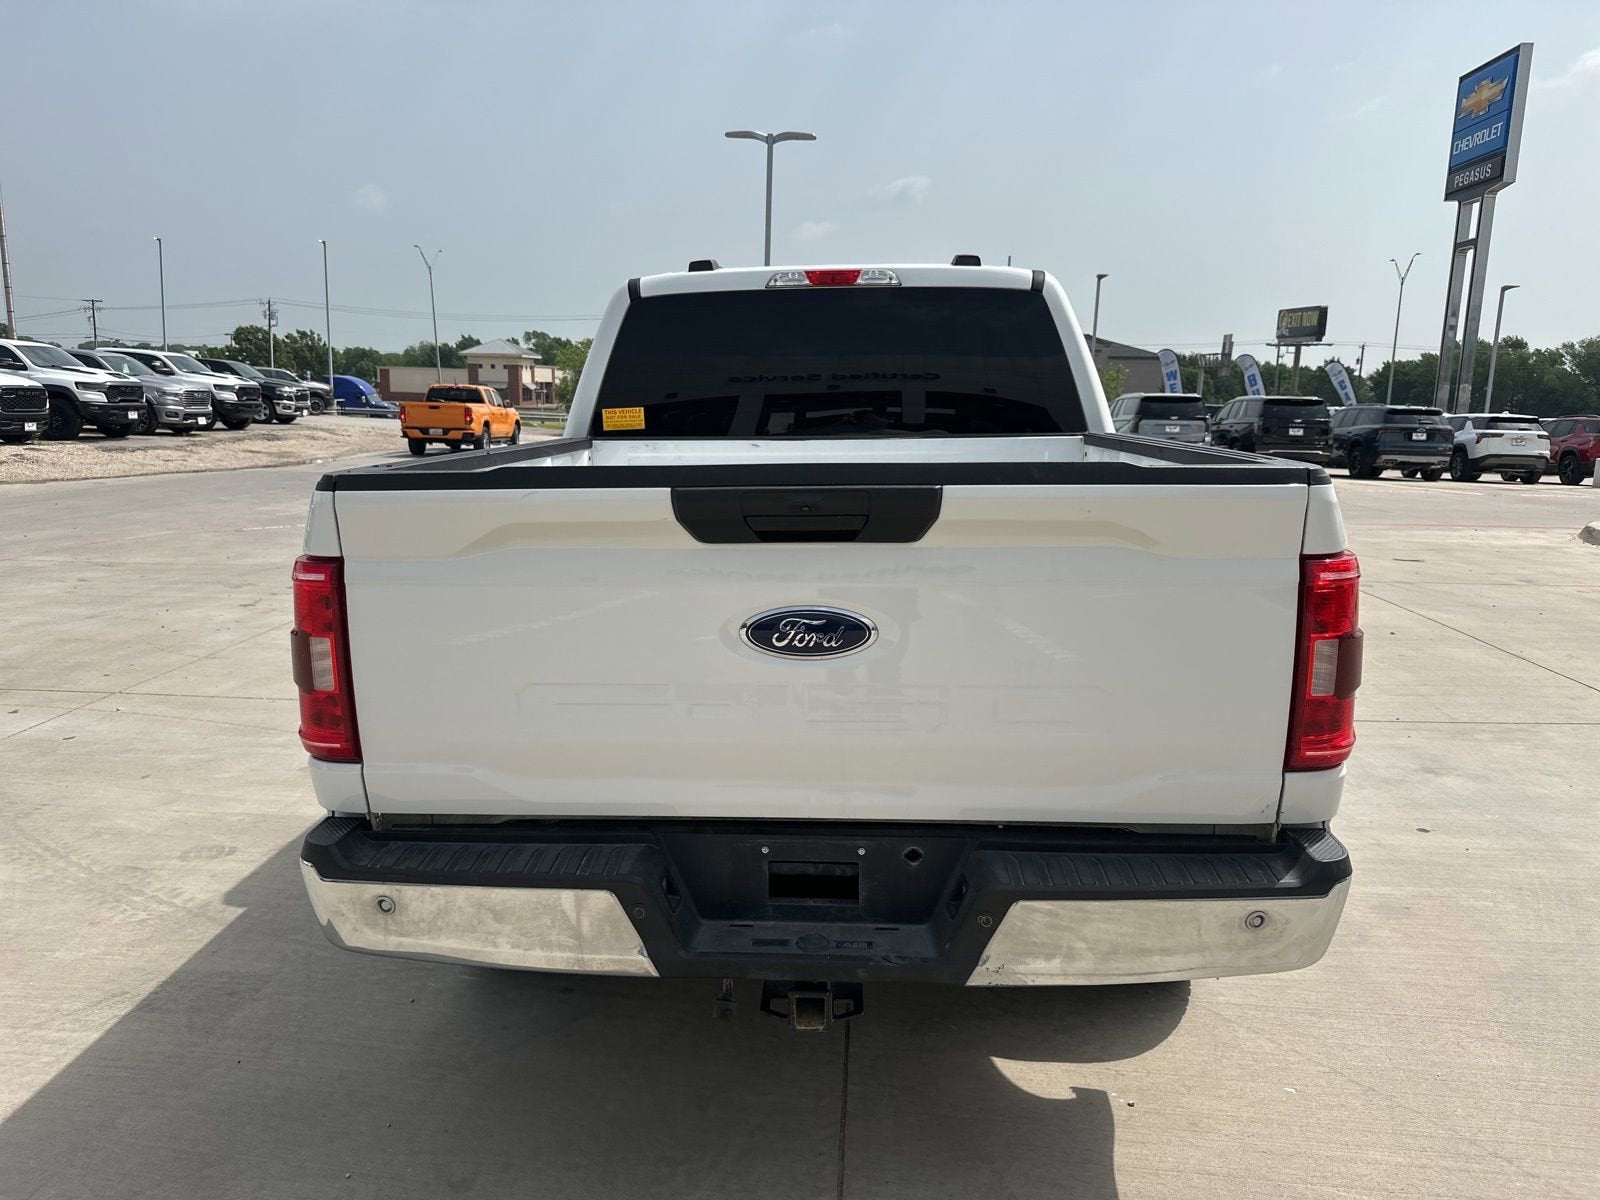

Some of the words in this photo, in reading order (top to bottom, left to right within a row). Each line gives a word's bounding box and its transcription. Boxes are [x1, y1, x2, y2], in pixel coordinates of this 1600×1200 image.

[1453, 122, 1503, 155] CHEVROLET
[1454, 164, 1492, 188] PEGASUS
[1302, 310, 1319, 327] NOW
[772, 617, 845, 647] Ford
